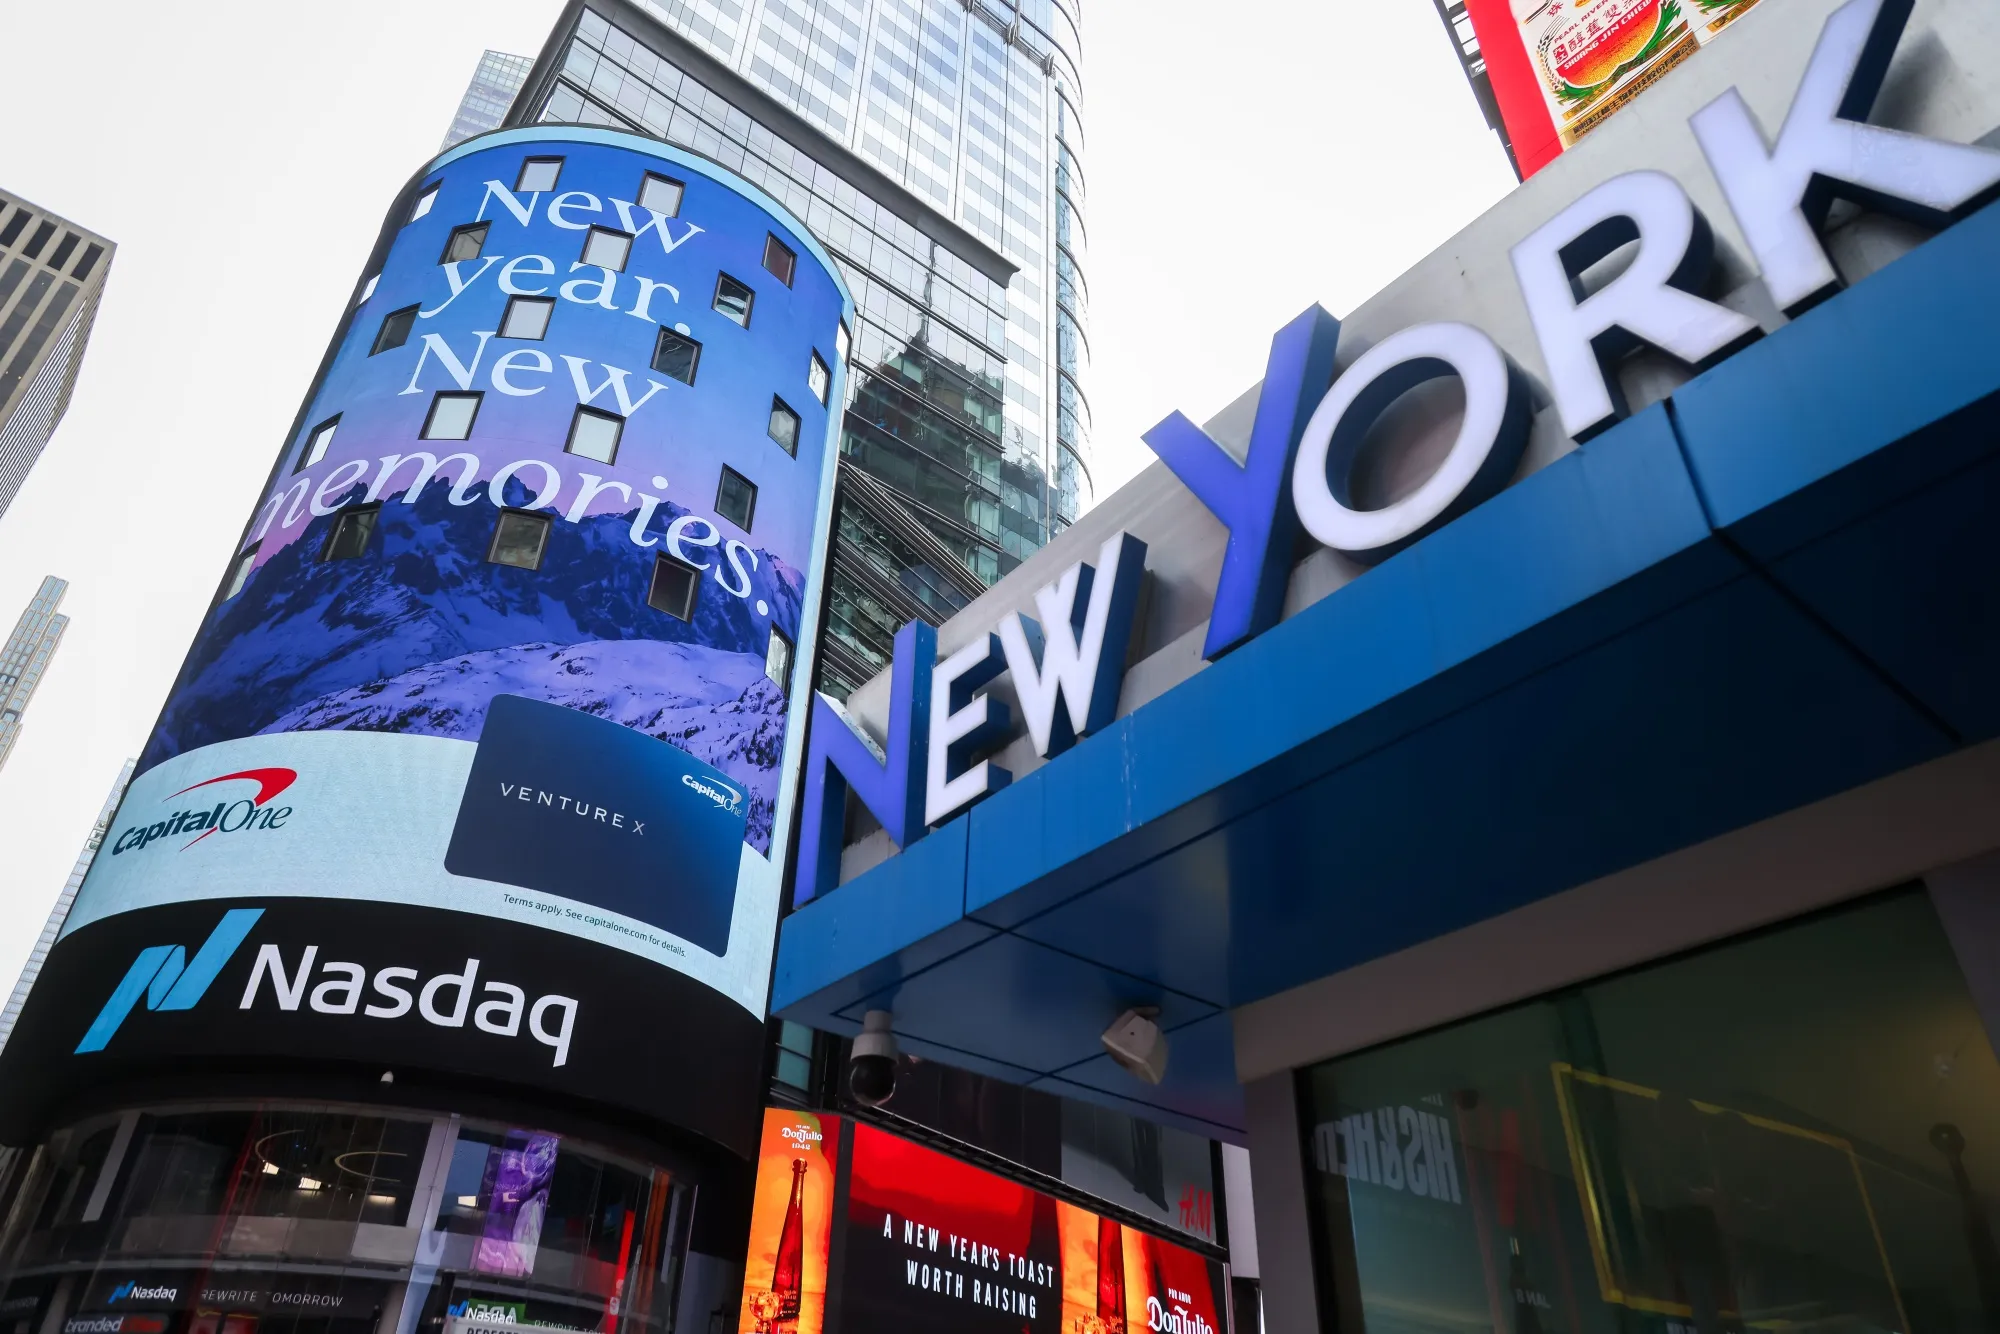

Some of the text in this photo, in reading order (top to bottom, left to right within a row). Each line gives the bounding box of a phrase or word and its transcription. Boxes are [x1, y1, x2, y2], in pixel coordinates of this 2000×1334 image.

[1554, 22, 1579, 43] PEARL
[1564, 41, 1599, 70] SHUANG
[1601, 25, 1620, 43] JIN
[475, 180, 706, 254] New
[418, 254, 691, 337] year.
[398, 331, 668, 417] New
[794, 0, 2000, 908] NEW YORK
[238, 450, 768, 616] memories.
[500, 782, 645, 836] VENTURE X
[503, 893, 687, 958] Terms apply. See capitalone.com for details.
[239, 943, 579, 1068] Nasdaq
[791, 1142, 811, 1150] 1942
[883, 1213, 1053, 1288] A NEW YEAR'S TOAST
[130, 1285, 177, 1301] Nasdaq
[201, 1289, 343, 1308] REWRITE OMORROW
[466, 1306, 514, 1326] Nasdaq
[907, 1259, 1036, 1319] WORTH RAISING
